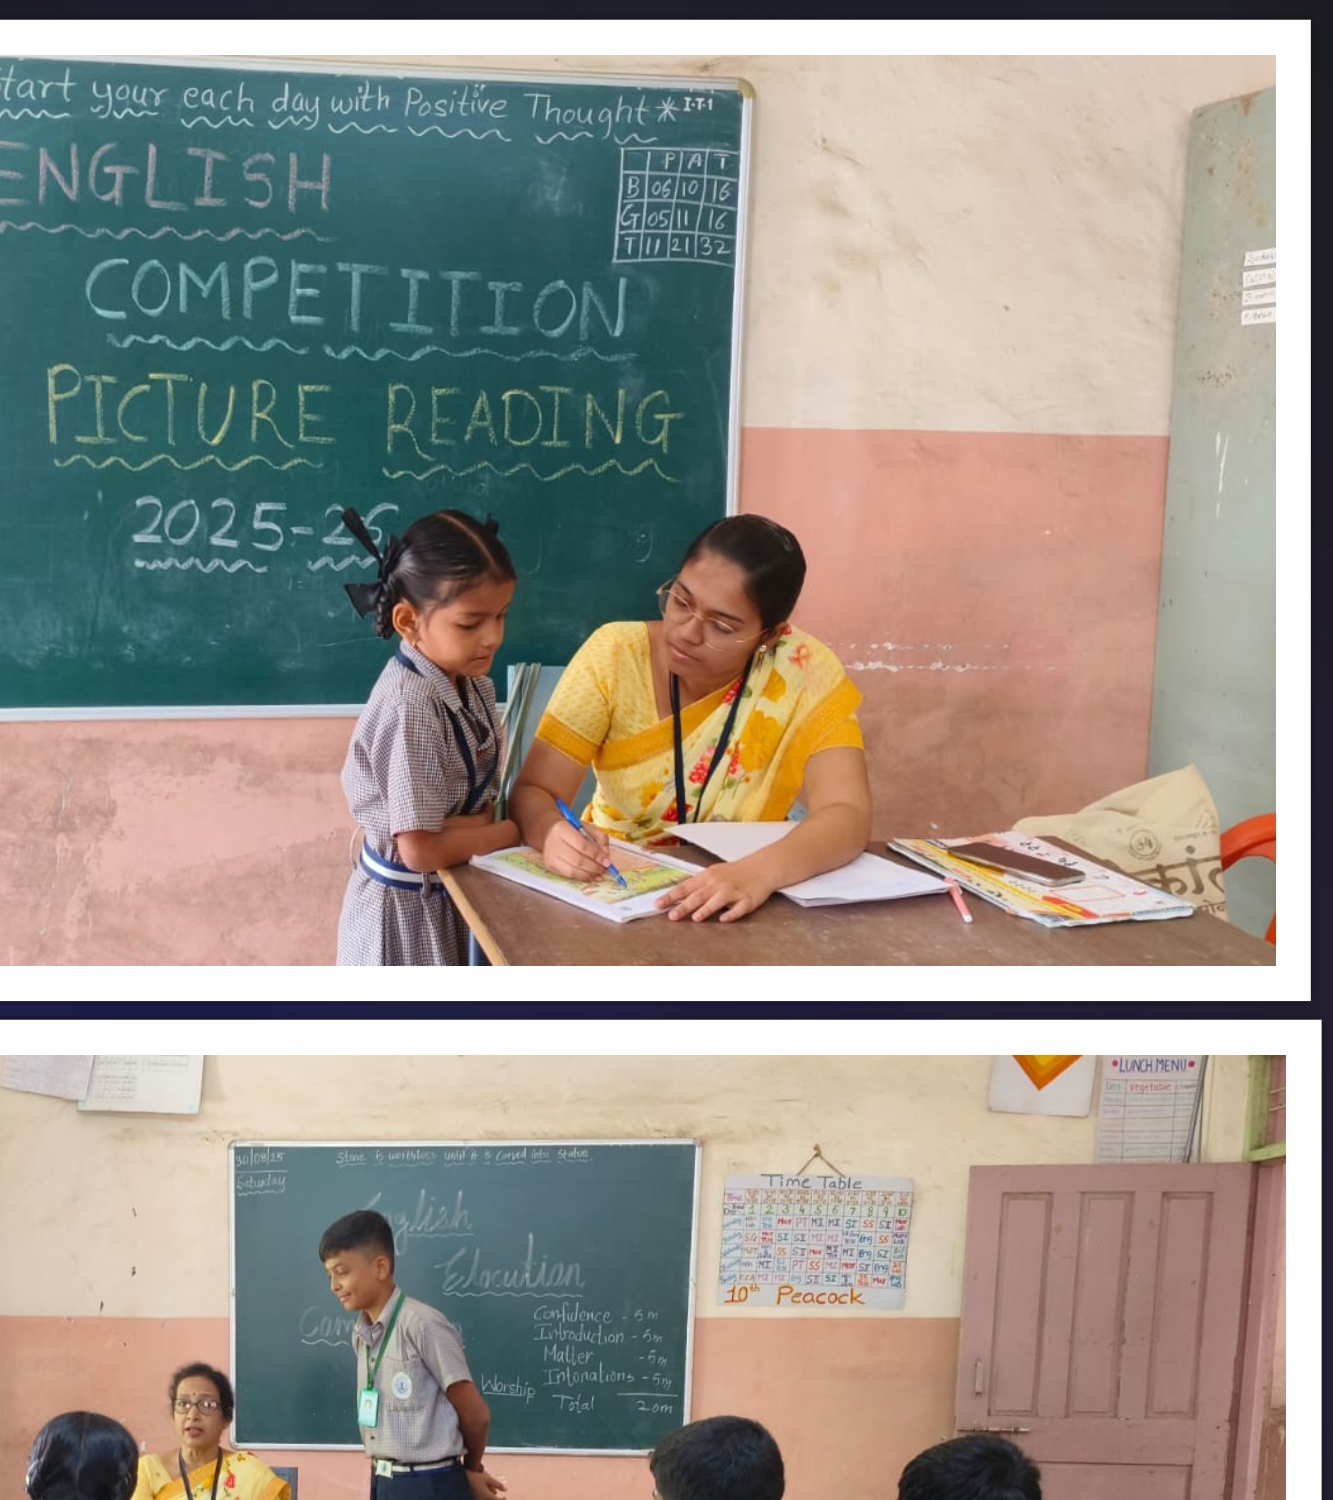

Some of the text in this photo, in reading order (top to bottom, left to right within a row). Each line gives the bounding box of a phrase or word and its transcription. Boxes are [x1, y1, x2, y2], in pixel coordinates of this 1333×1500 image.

[92, 81, 169, 116] your
[183, 82, 255, 114] each
[272, 81, 320, 130] day
[331, 79, 390, 117] with
[405, 83, 508, 119] Positive
[524, 91, 650, 140] Thought
[664, 152, 730, 170] P A T
[626, 175, 731, 203] B 06 10 16
[647, 209, 671, 227] 05
[677, 208, 689, 229] 11
[708, 208, 728, 230] 16
[624, 237, 731, 256] T 11 21 32
[85, 256, 628, 339] COMPETITION
[47, 362, 684, 463] PICTURE READING
[1119, 1057, 1187, 1072] LUNCH MENU
[761, 1174, 863, 1189] Time Table
[359, 1187, 474, 1256] nglish
[434, 1232, 586, 1292] Elocution
[776, 1286, 865, 1305] Peacock
[534, 1302, 613, 1324] Confidence
[534, 1323, 624, 1345] Introduction
[481, 1373, 536, 1404] Worship
[552, 1394, 594, 1414] Total
